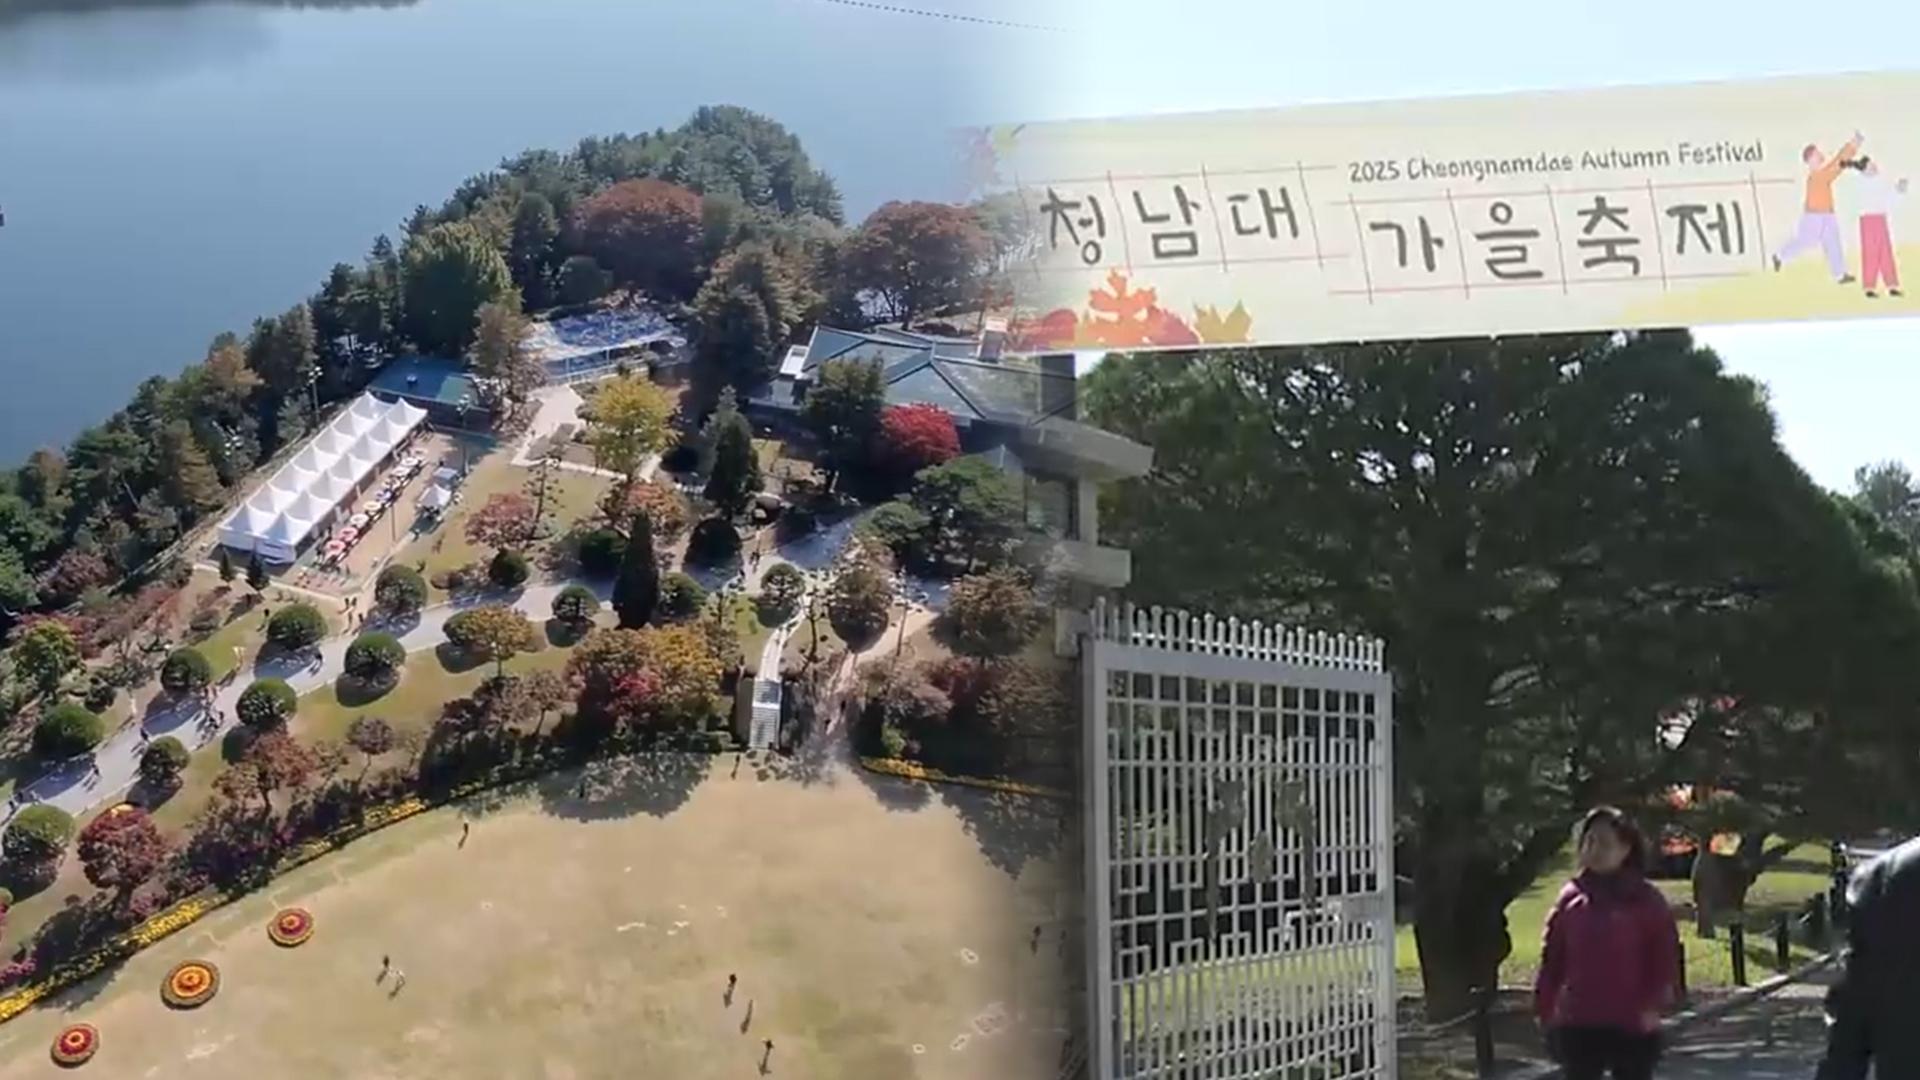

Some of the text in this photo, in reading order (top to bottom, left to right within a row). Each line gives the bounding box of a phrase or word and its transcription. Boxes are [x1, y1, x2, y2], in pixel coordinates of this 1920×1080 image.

[1349, 140, 1764, 183] 2025 Cheongnamdae Autumn Festival
[1040, 186, 1299, 264] 청남대
[1369, 196, 1746, 279] 가을축제
